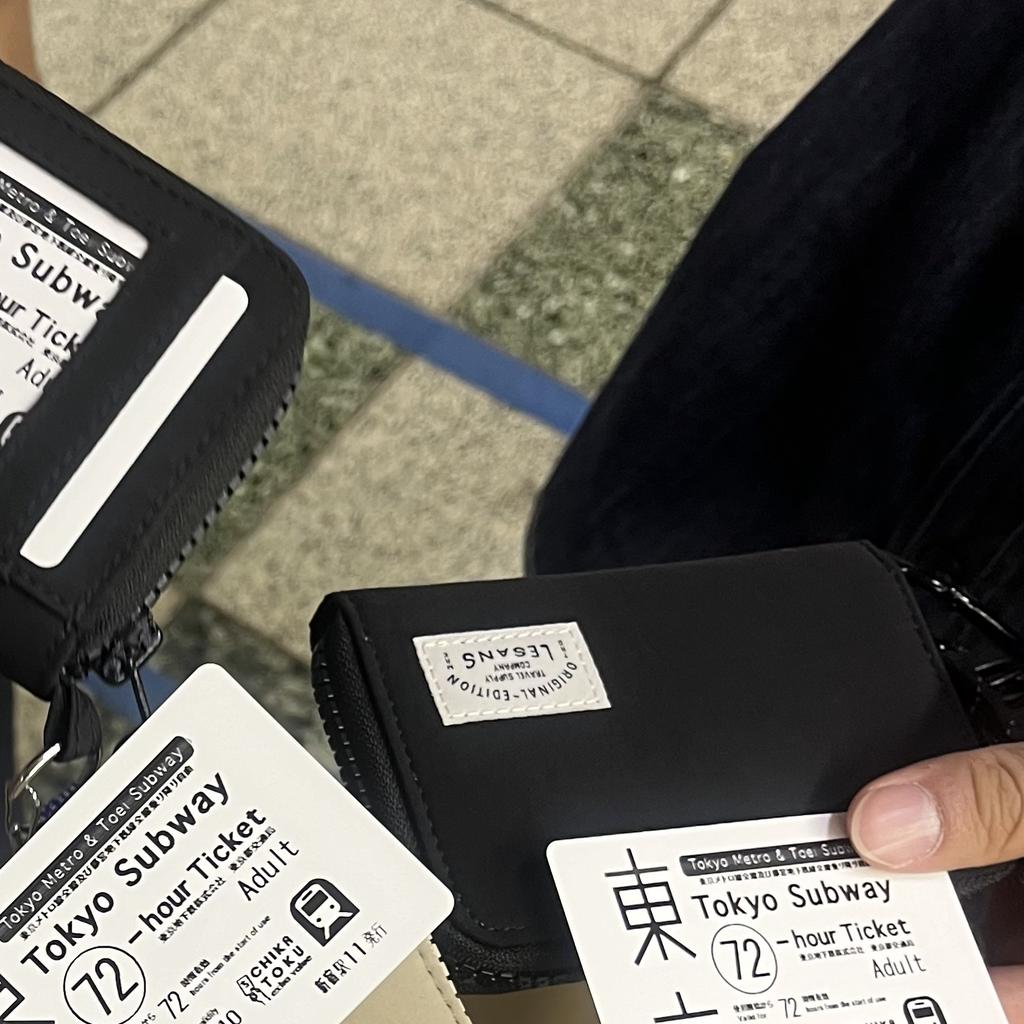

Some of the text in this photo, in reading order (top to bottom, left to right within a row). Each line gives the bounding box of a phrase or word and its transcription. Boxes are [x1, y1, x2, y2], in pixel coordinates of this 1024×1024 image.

[62, 216, 90, 246] Toe
[10, 242, 102, 311] Subw
[30, 307, 87, 358] Tick
[461, 643, 555, 670] LESANS
[484, 669, 547, 683] TRAVEL SUPPLY
[493, 660, 532, 672] COMPANY
[40, 848, 84, 890] Metro
[83, 833, 99, 848] &
[95, 801, 131, 832] Toei
[128, 746, 184, 801] Subway
[19, 771, 229, 975] Tokyo Subway
[236, 840, 300, 902] Adult
[686, 857, 730, 872] Tokyo
[731, 852, 772, 866] Metro
[774, 848, 787, 862] &
[70, 957, 140, 1017] 72
[185, 808, 267, 881] Ticket
[690, 878, 891, 921] Tokyo Subway
[249, 935, 295, 979] CHIKA
[259, 944, 305, 988] TOKU
[718, 937, 772, 981] 72
[838, 918, 912, 943] Ticket
[871, 953, 927, 980] Adult
[156, 990, 191, 1021] 72
[776, 996, 802, 1020] 72
